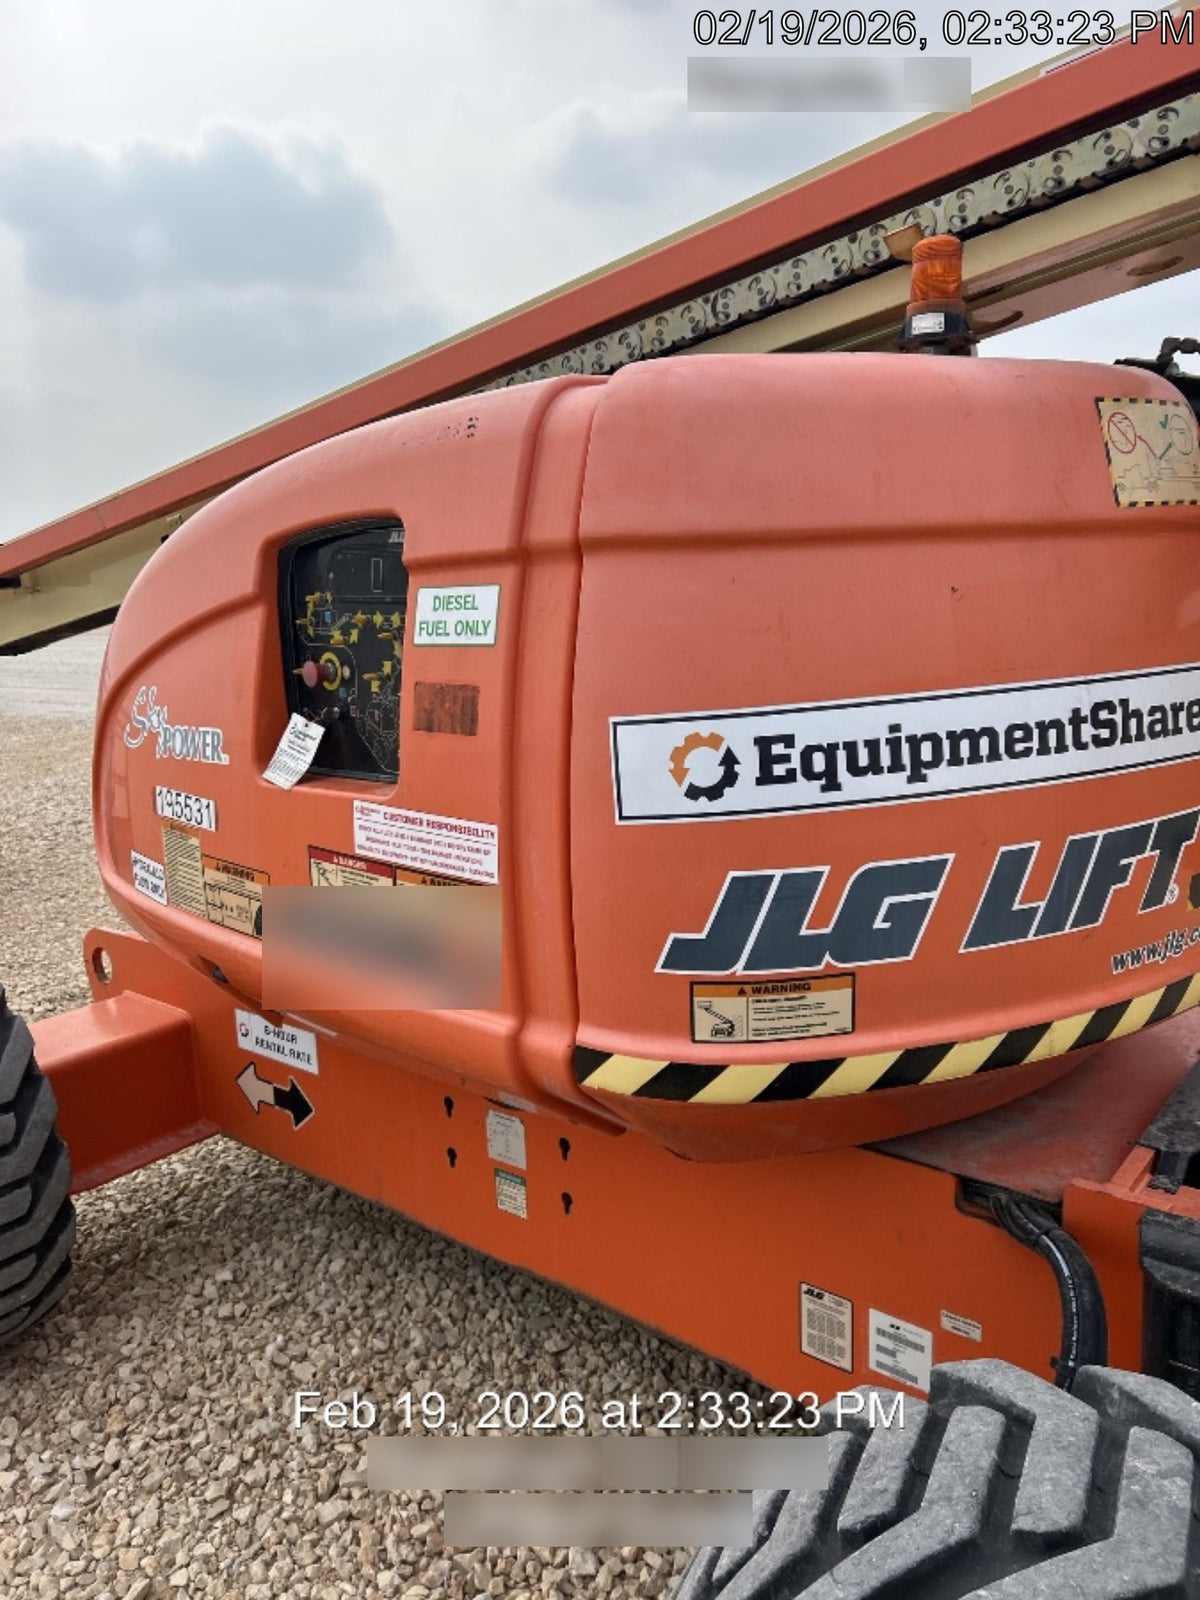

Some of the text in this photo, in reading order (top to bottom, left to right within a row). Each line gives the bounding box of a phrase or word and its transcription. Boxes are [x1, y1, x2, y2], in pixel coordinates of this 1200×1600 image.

[432, 594, 479, 612] DIESEL
[418, 619, 491, 637] FUEL ONLY
[753, 698, 1200, 793] EquipmentShare
[157, 788, 213, 829] 195531
[383, 811, 424, 827] CUSTOMER
[426, 818, 496, 840] RESPONSIBILITY
[654, 853, 956, 976] JLG
[751, 983, 812, 995] WARNING
